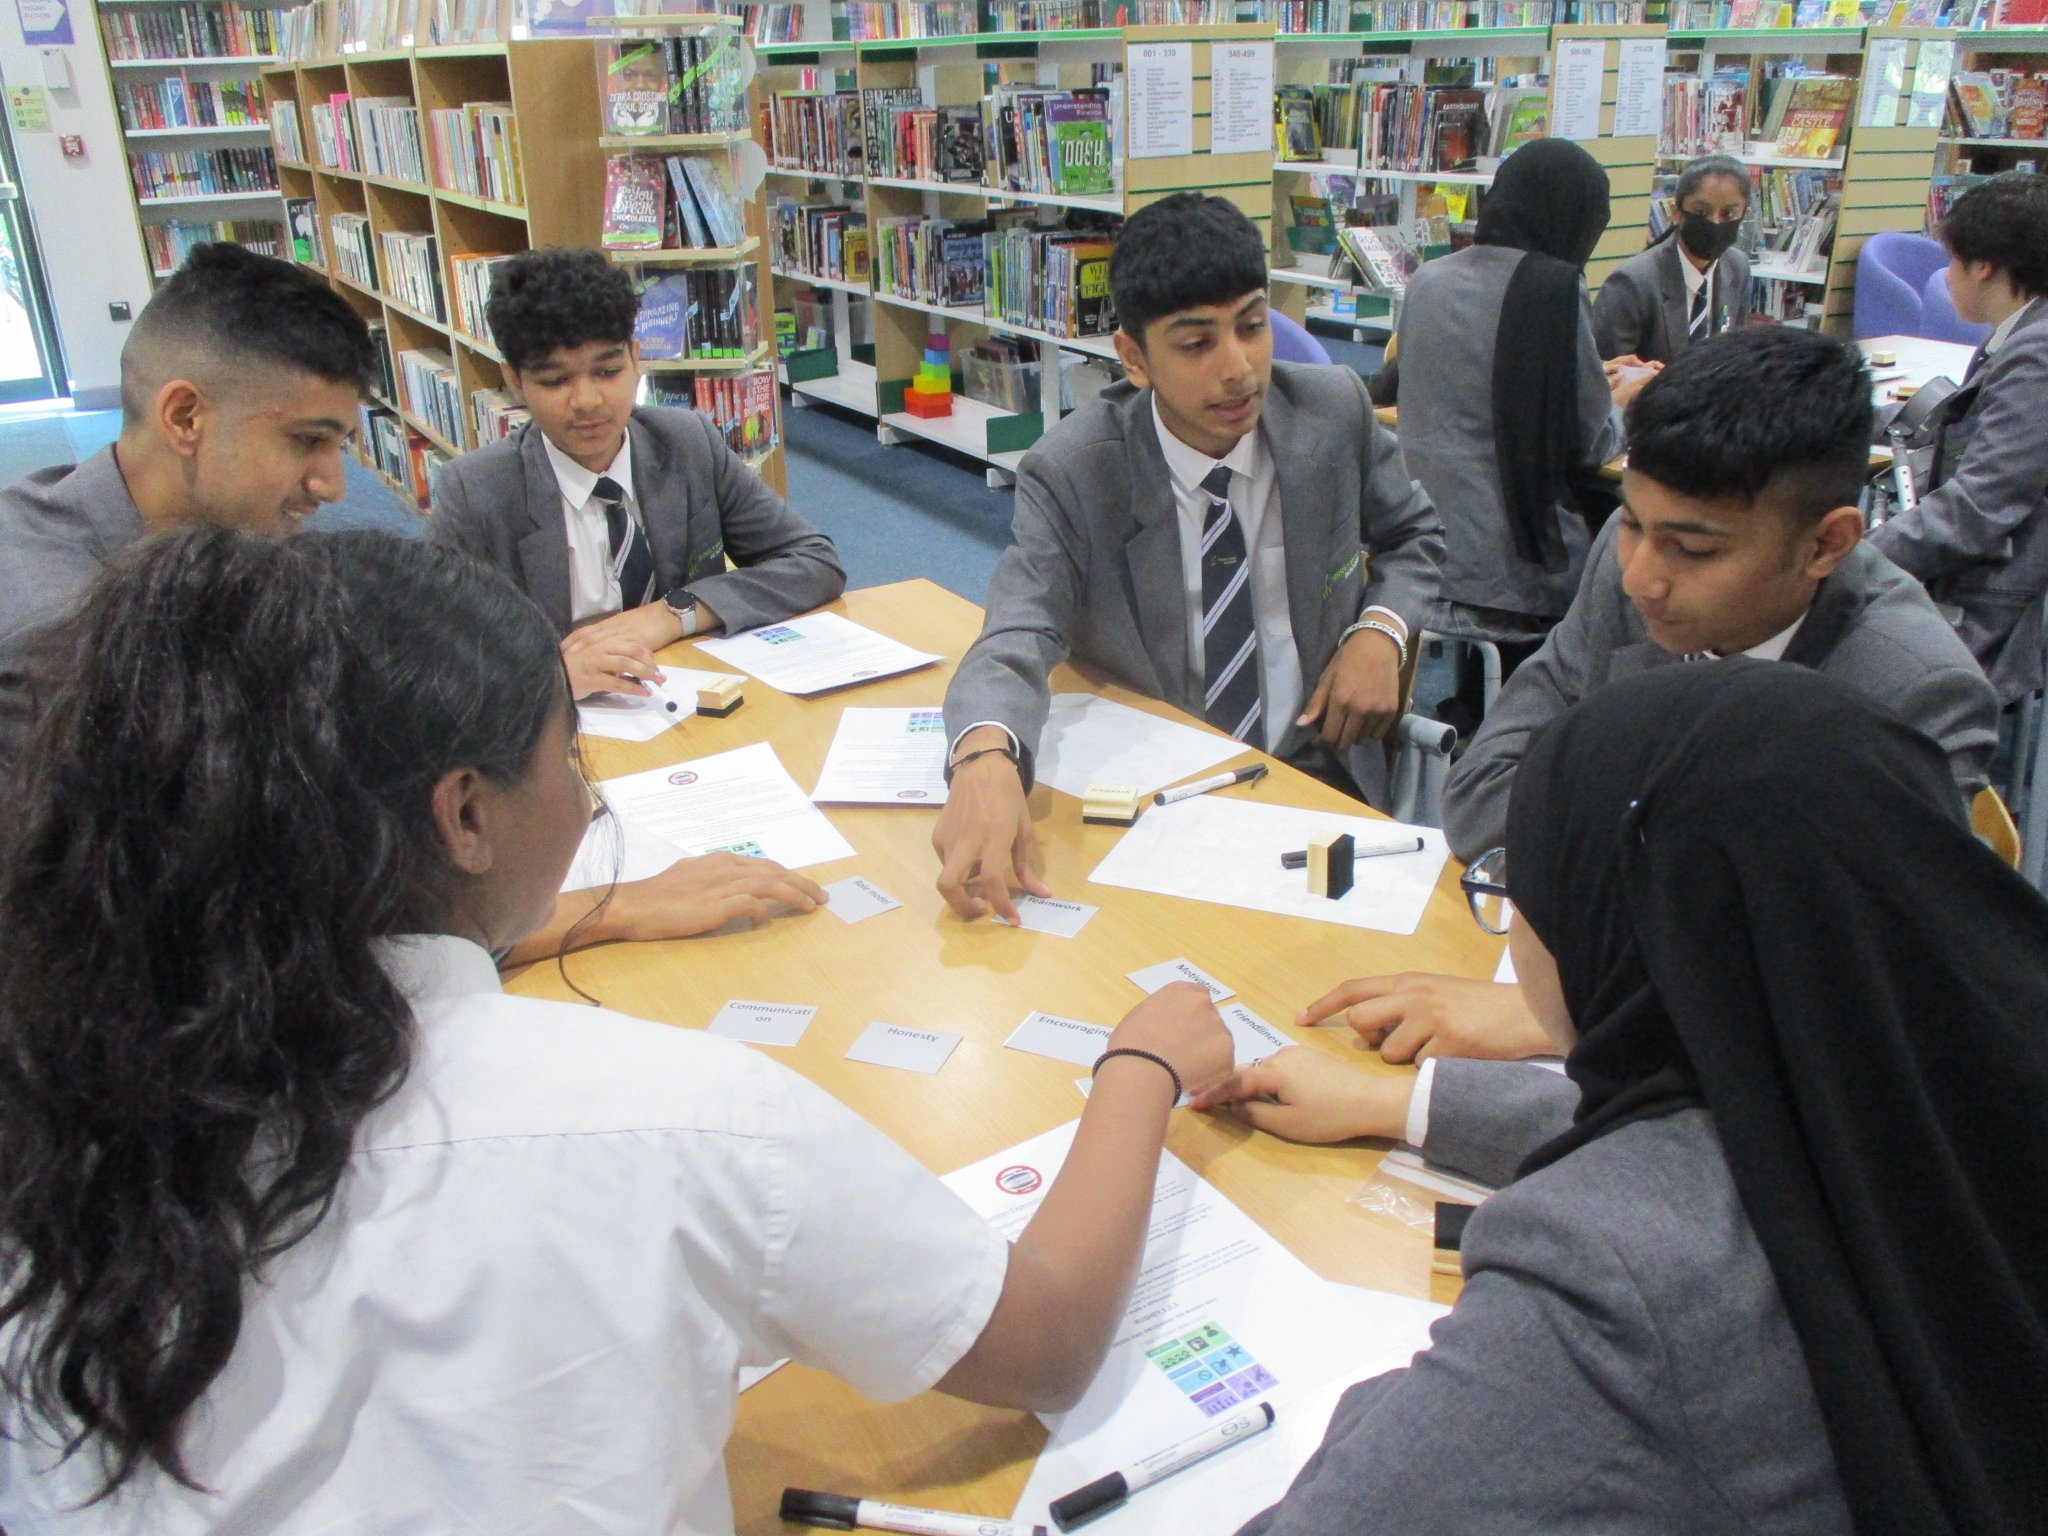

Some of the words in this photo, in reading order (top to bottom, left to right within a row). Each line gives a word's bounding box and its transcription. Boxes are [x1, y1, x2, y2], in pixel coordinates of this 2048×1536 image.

[609, 92, 632, 102] ZEBRA
[633, 90, 667, 101] CROSSING
[1791, 118, 1831, 128] CASTLE
[1025, 896, 1083, 912] Teamwork
[1175, 963, 1222, 996] Motivation
[729, 1001, 812, 1016] Communicati
[755, 1015, 772, 1023] on
[886, 1026, 939, 1043] Honesty
[1231, 1008, 1284, 1048] Friendliness
